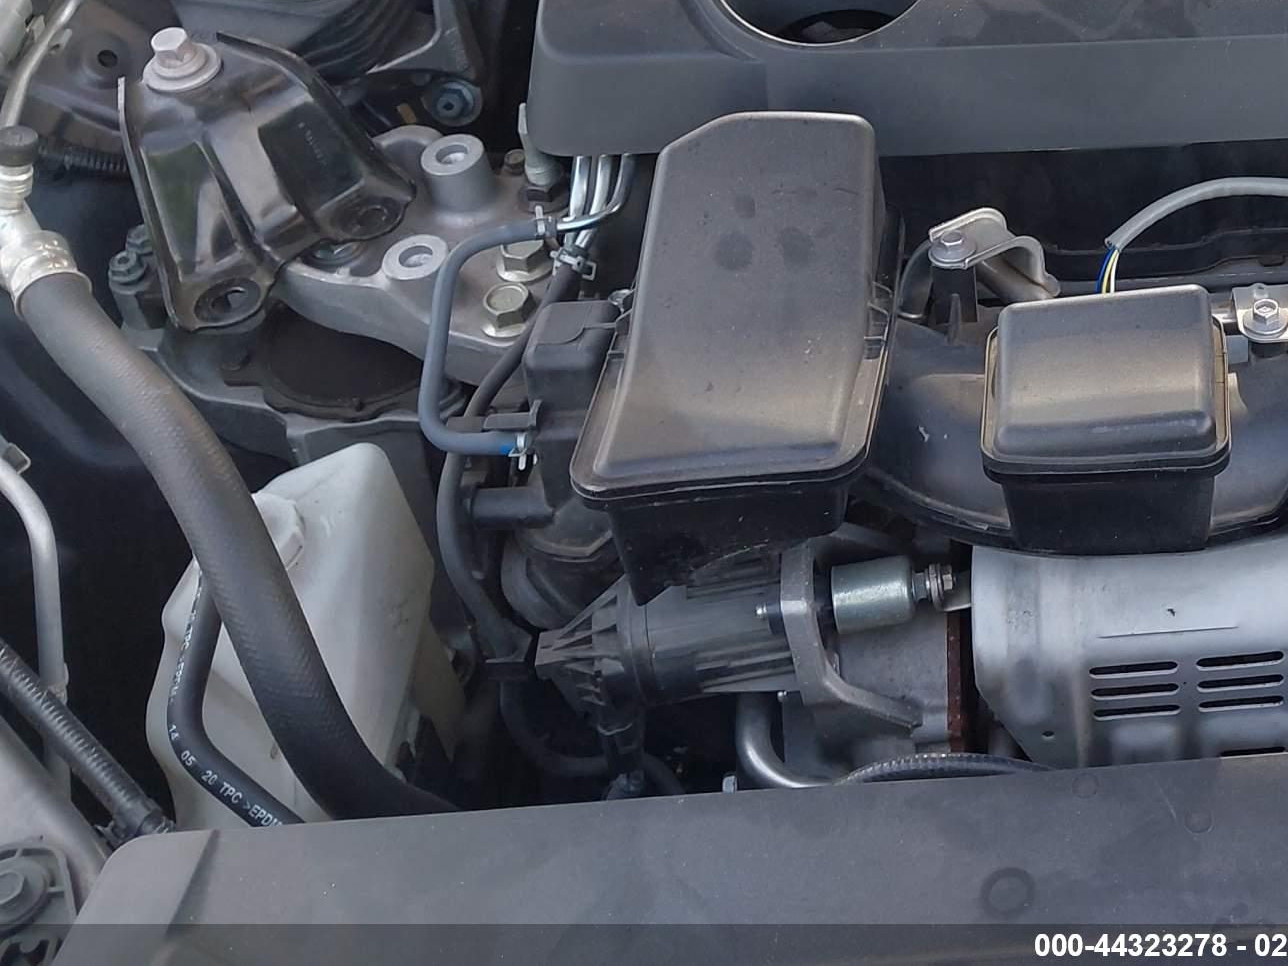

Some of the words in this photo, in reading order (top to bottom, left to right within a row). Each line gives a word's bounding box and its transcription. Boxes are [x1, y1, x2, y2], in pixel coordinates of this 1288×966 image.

[168, 724, 180, 741] 14
[181, 750, 197, 766] 05
[201, 770, 218, 785] 20
[219, 781, 242, 804] TPC
